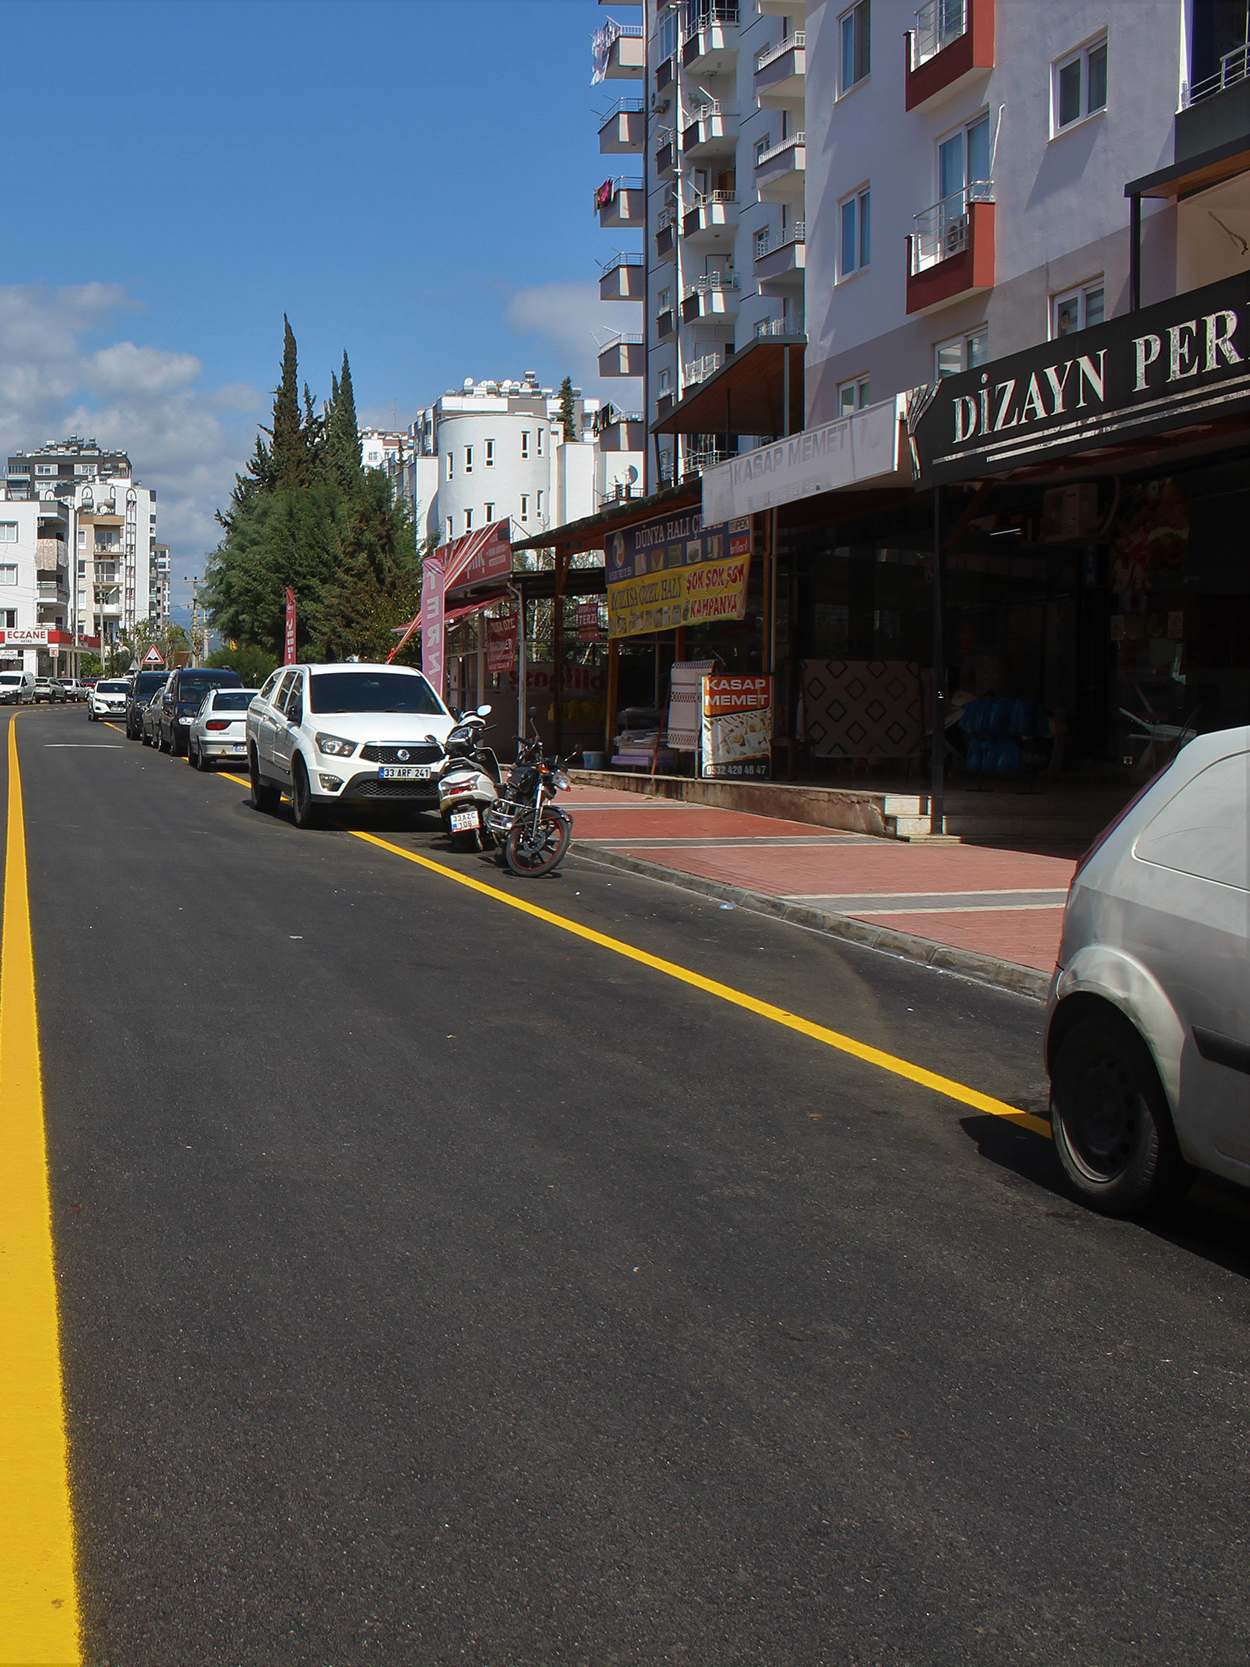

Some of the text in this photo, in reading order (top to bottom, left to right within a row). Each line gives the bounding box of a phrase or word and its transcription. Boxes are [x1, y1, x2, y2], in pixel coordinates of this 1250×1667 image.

[952, 302, 1250, 445] DİZAYN PER
[733, 422, 849, 485] KASAP MEMET
[635, 524, 665, 550] DÜNYA
[666, 517, 690, 540] HALI
[686, 569, 704, 594] ŞOK
[706, 567, 725, 592] ŞOK
[690, 594, 737, 619] KAMPANYA
[7, 630, 46, 639] ECZANE
[706, 679, 766, 690] KASAP
[705, 694, 768, 706] MEMET
[384, 769, 429, 777] 33 ARF 241
[706, 765, 766, 775] 0532 420 46 47
